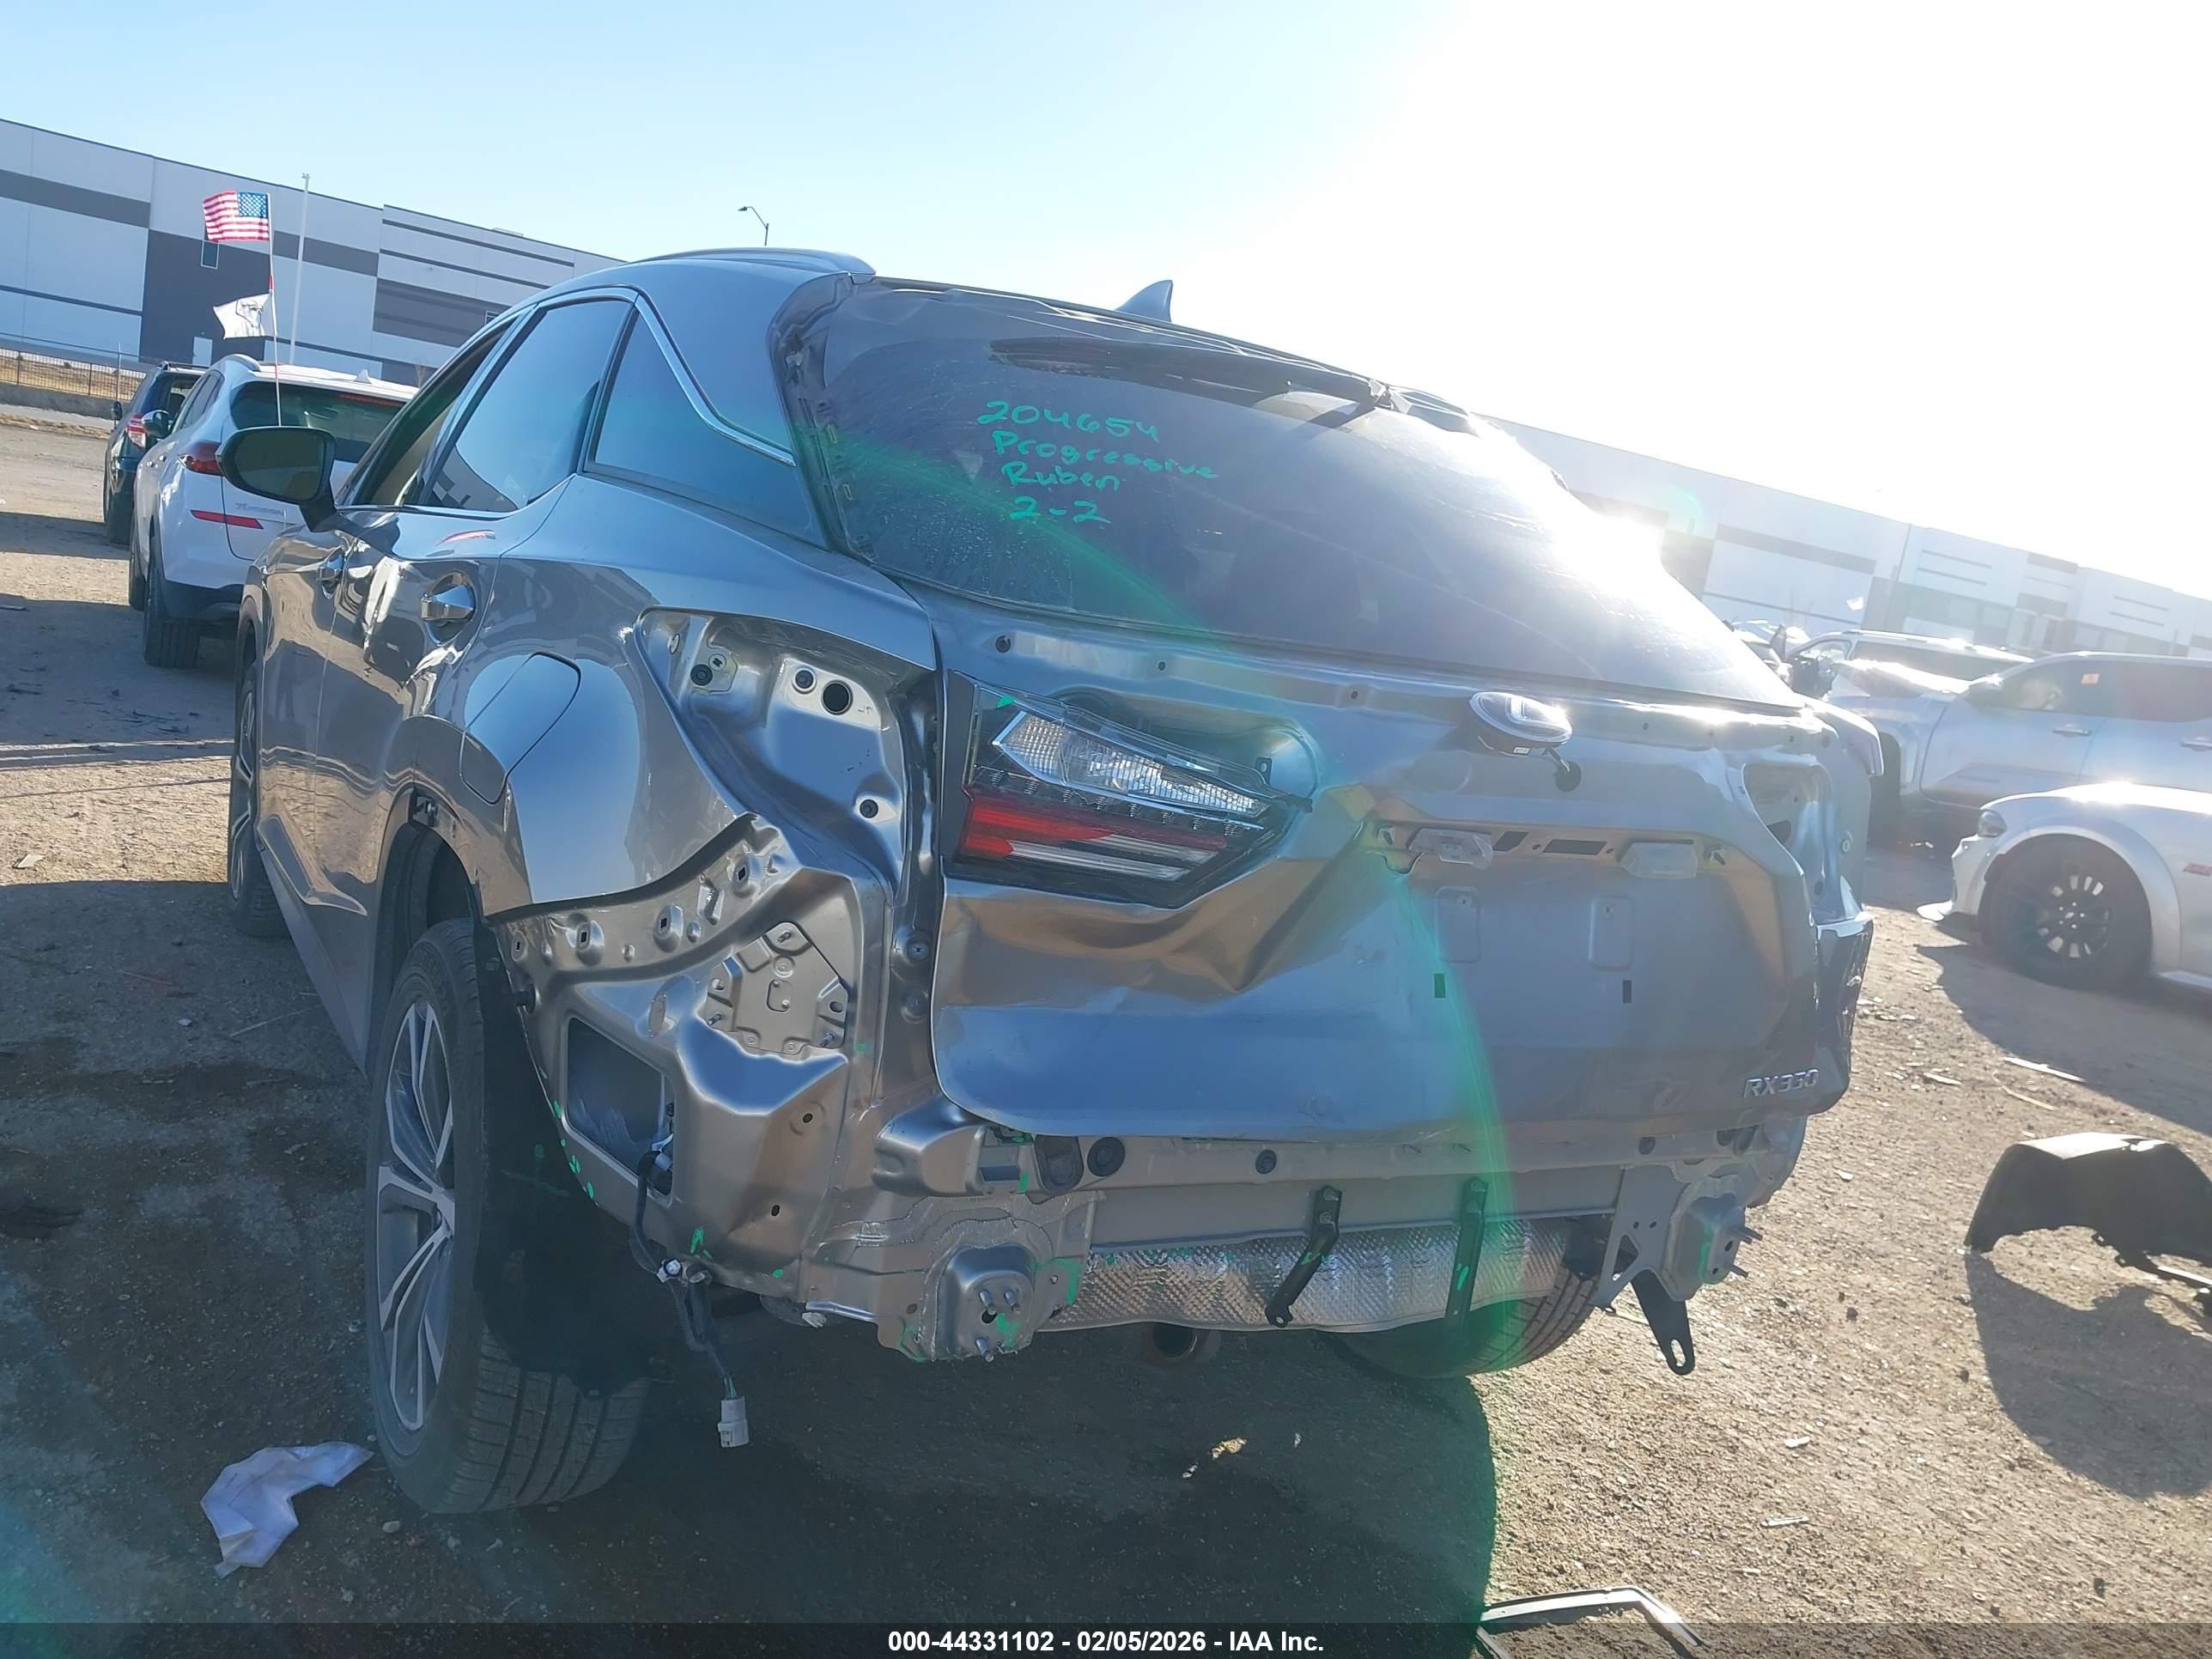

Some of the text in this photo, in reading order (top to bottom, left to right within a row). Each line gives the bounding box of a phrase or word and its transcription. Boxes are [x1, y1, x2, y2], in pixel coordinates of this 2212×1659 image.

[978, 400, 1159, 443] 204654
[1002, 461, 1121, 490] Ruben
[1743, 1068, 1820, 1098] RX350
